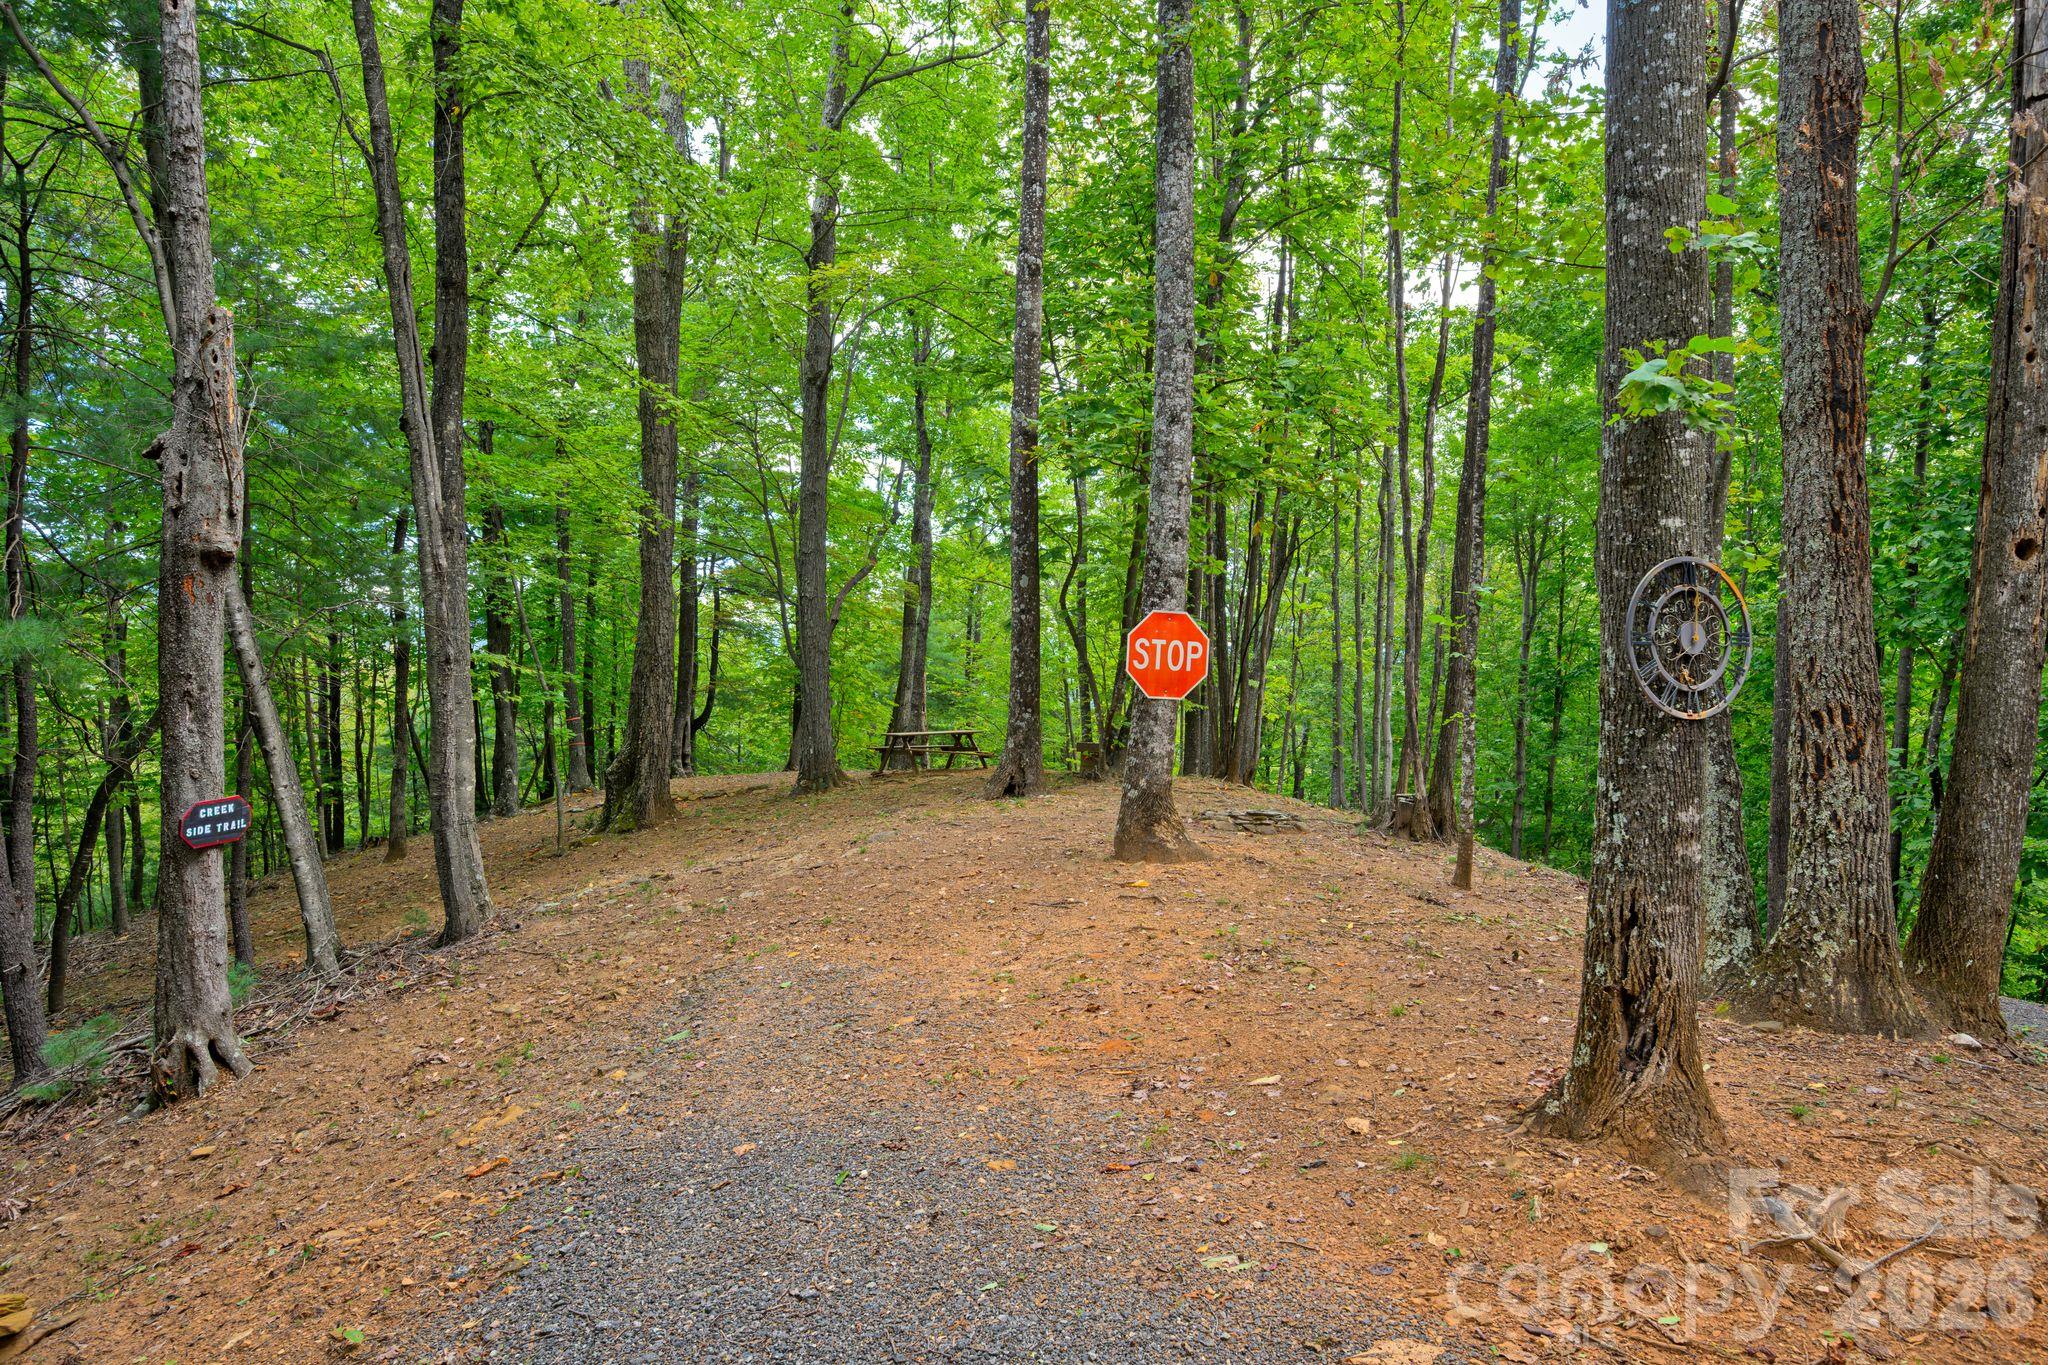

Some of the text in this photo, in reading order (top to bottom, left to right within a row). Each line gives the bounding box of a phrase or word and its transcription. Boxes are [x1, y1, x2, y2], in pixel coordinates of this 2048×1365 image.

[1132, 637, 1203, 671] STOP
[199, 803, 235, 818] CREEK
[186, 818, 247, 837] SIDE TRAIL
